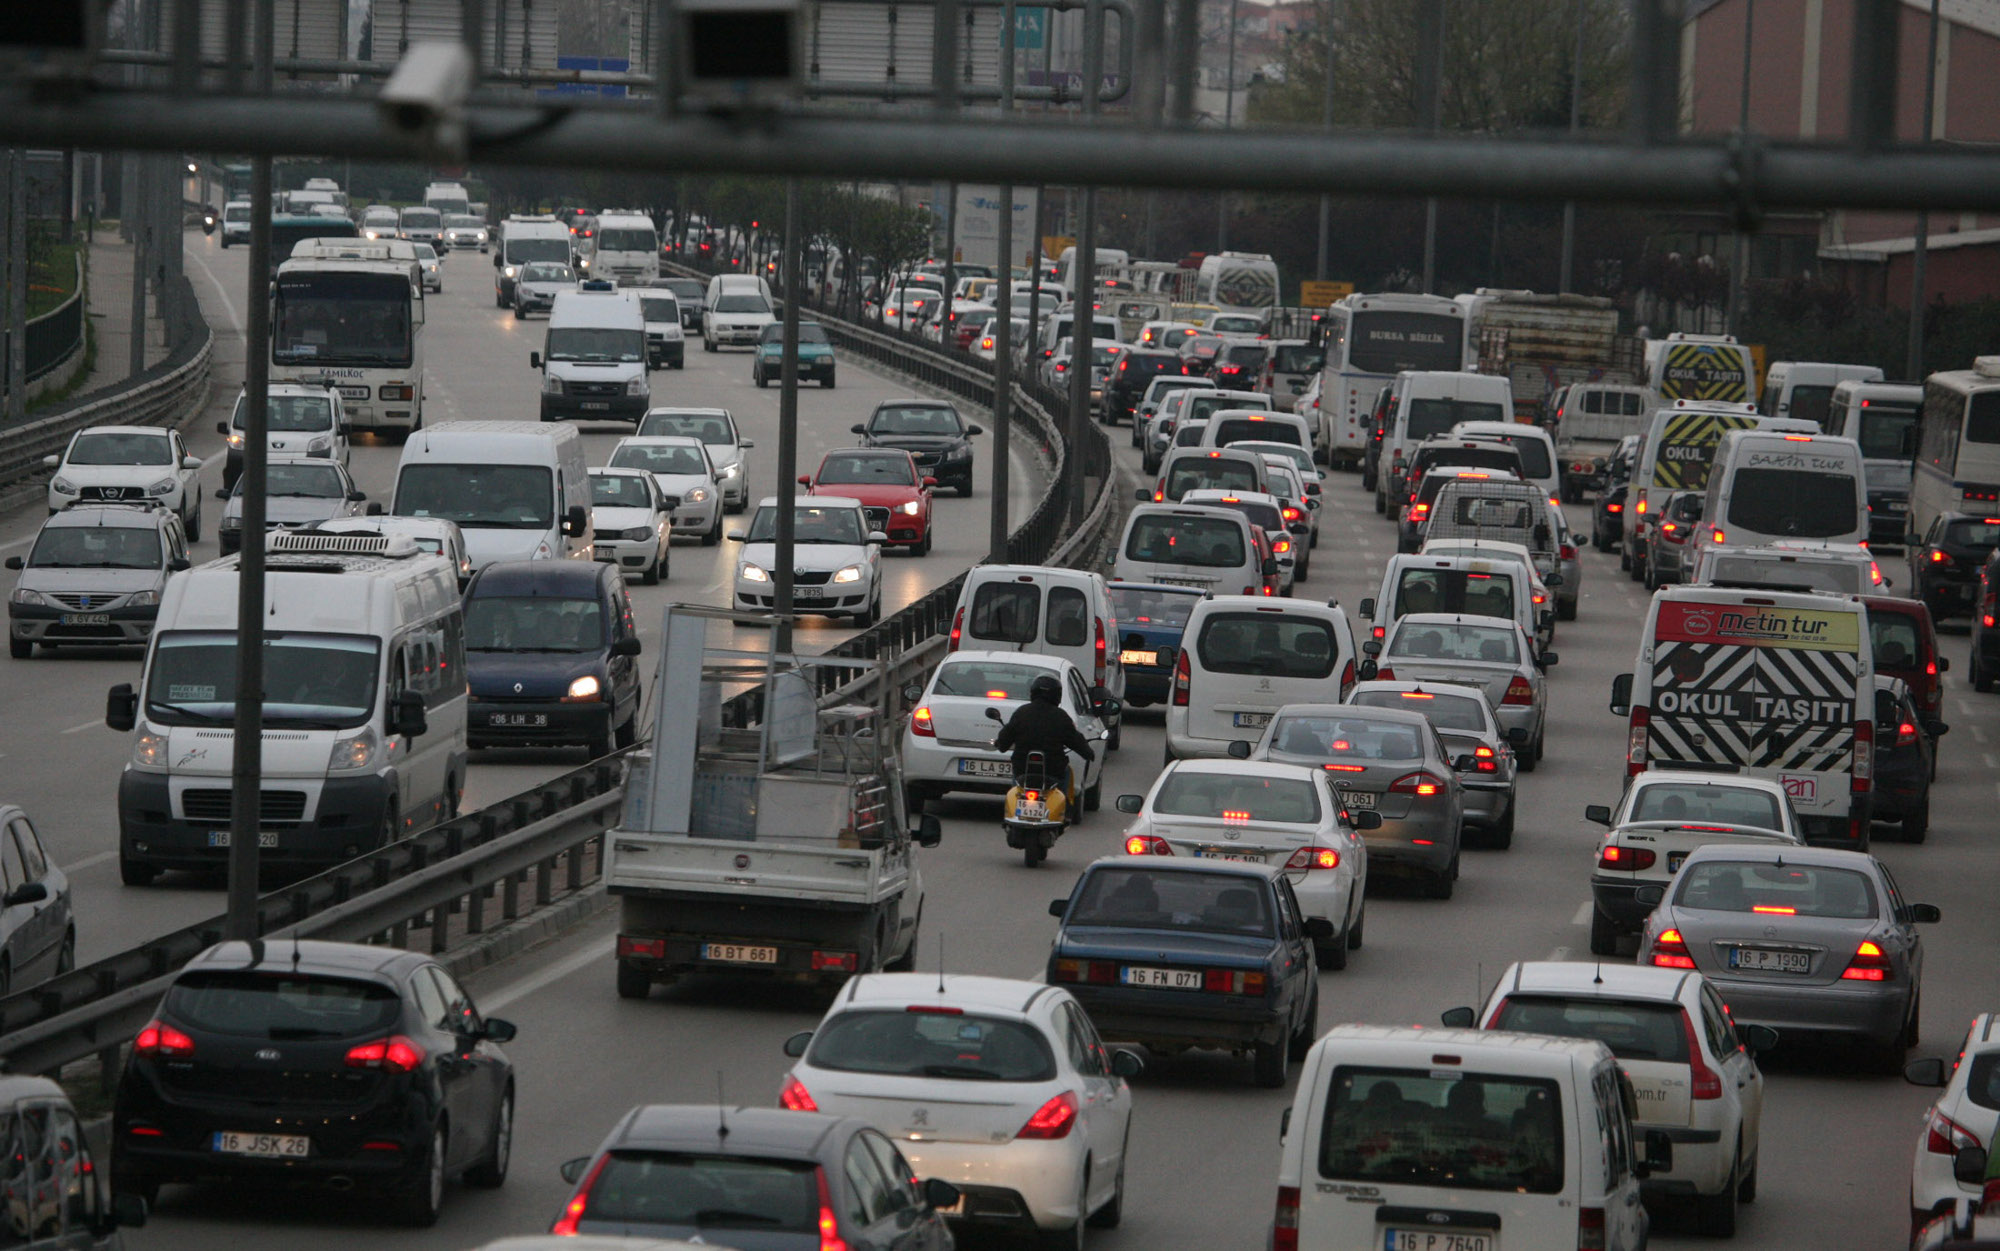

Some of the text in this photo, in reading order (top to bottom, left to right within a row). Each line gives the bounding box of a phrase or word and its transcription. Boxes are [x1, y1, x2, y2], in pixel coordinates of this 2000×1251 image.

[1370, 331, 1404, 340] BURSA
[1668, 368, 1698, 380] OKUL
[1665, 446, 1705, 461] OKUL
[65, 615, 108, 624] 16 GV 443
[1658, 691, 1849, 725] OKUL TAŞITI
[495, 714, 546, 724] 06 LIH 38
[1243, 714, 1252, 724] 16
[965, 760, 976, 770] 16
[980, 761, 995, 772] LA
[1781, 775, 1815, 798] tan
[1352, 794, 1372, 804] 061
[217, 833, 227, 844] 16
[708, 946, 773, 960] 16 BT 661
[1739, 951, 1807, 967] 16 P 1990
[1132, 971, 1197, 986] 16 FN 071
[1635, 1089, 1666, 1101] om.tr
[223, 1135, 305, 1154] 16 JSK 26
[1400, 1233, 1484, 1251] 16 P 7640
